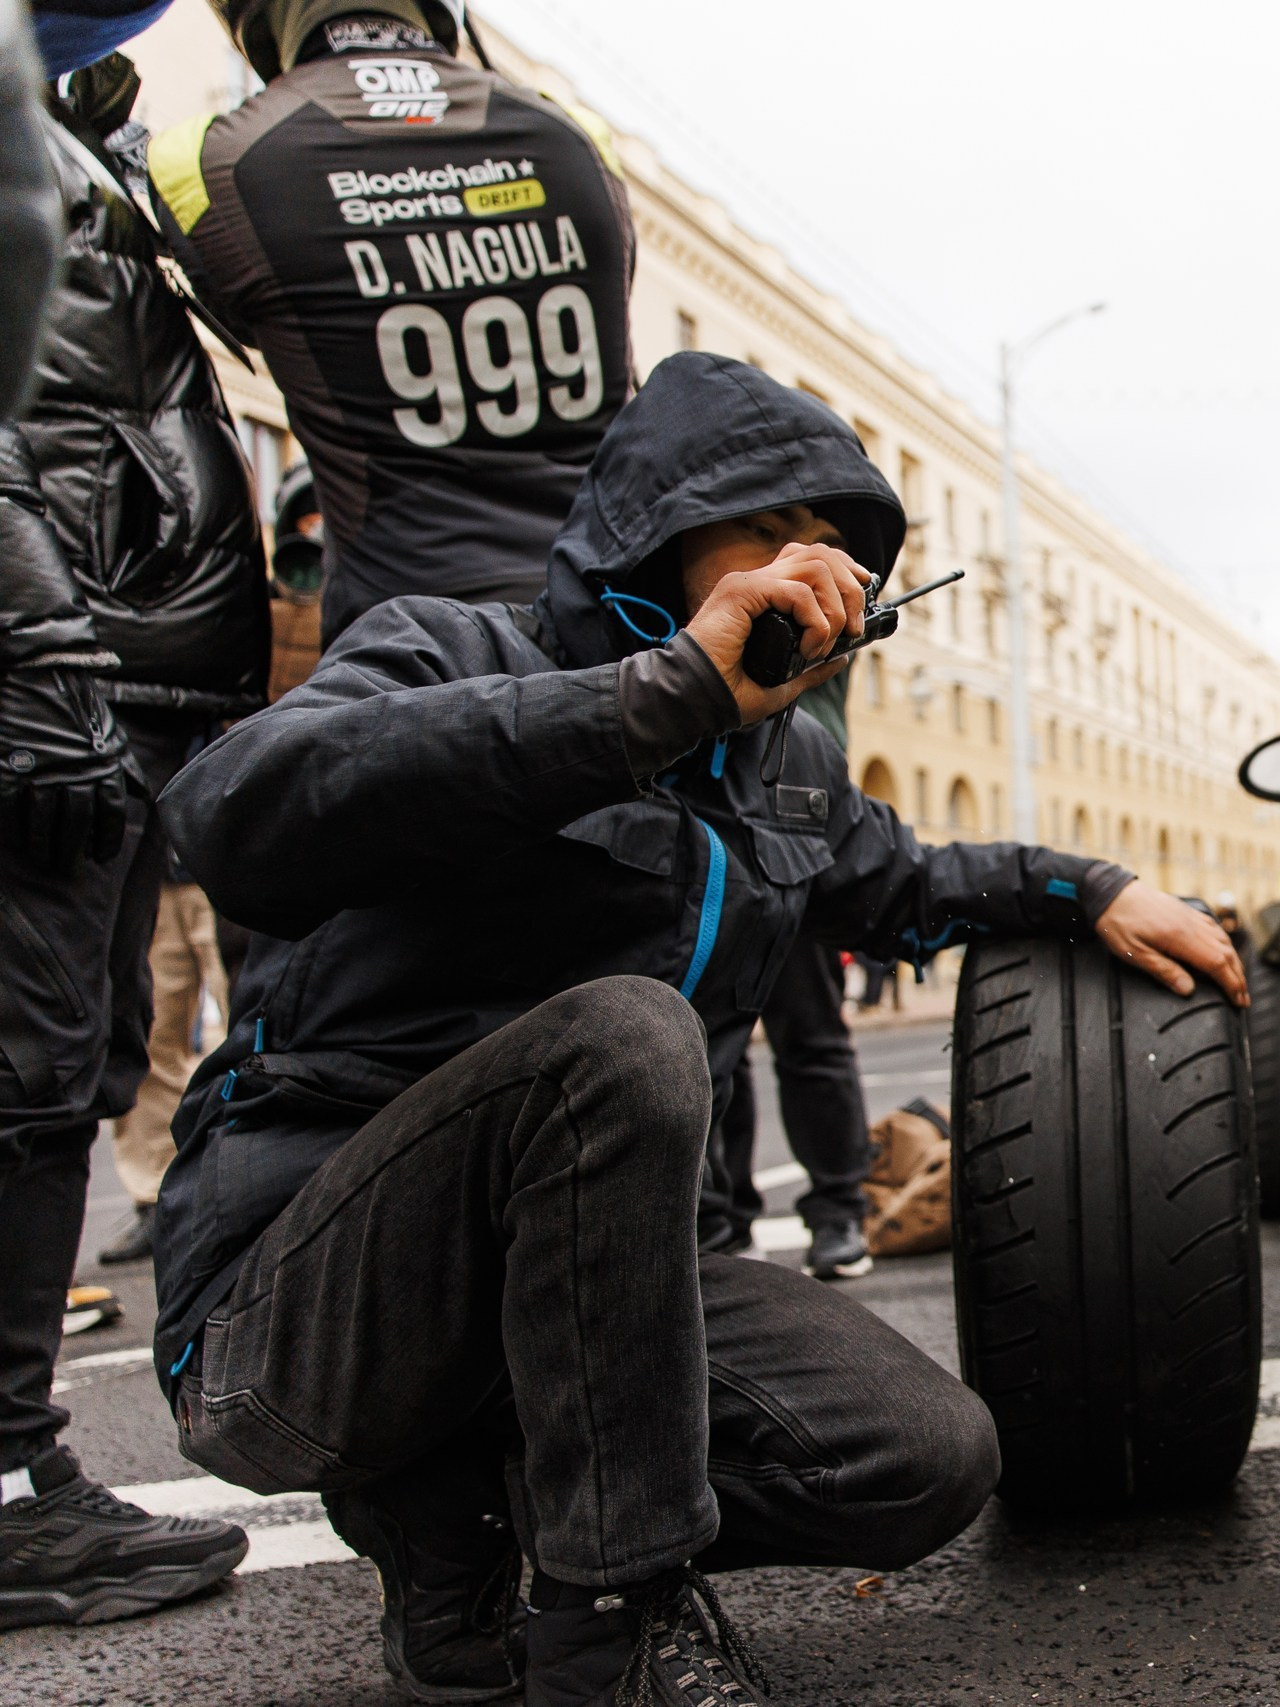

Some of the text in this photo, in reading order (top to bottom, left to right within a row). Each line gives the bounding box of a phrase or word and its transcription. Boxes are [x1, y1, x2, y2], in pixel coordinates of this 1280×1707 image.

[354, 66, 441, 94] OMP
[328, 158, 517, 199] Blockchain
[339, 186, 534, 227] Sports DRIFT
[344, 215, 588, 299] D. NAGULA
[375, 284, 604, 448] 999
